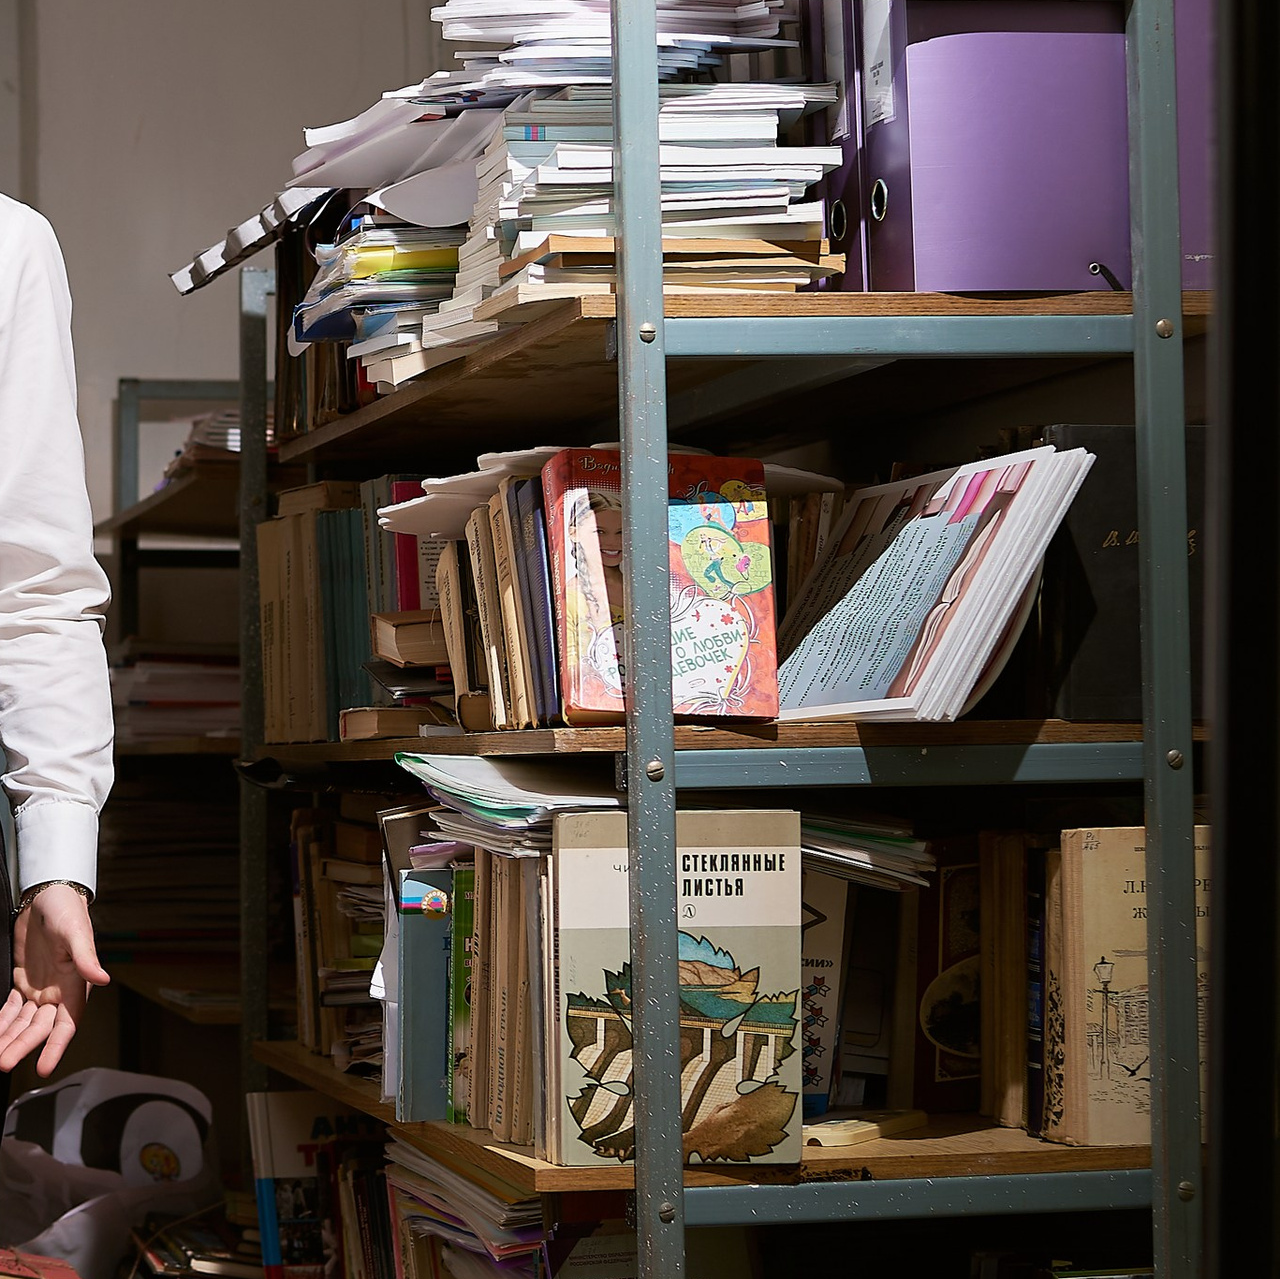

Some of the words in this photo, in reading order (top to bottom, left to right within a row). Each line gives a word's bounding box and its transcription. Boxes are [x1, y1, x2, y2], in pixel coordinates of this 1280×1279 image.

[553, 551, 561, 595] ДЕВОЧЕК
[676, 646, 687, 659] О
[693, 631, 743, 656] ЛЮБВИ
[672, 650, 733, 677] ДЕВОЧЕК
[681, 853, 787, 872] СТЕКЛЯННЫЕ
[681, 878, 745, 897] ЛИСТЬЯ
[496, 1046, 507, 1100] РОДНОЙ
[496, 1101, 504, 1126] ПО
